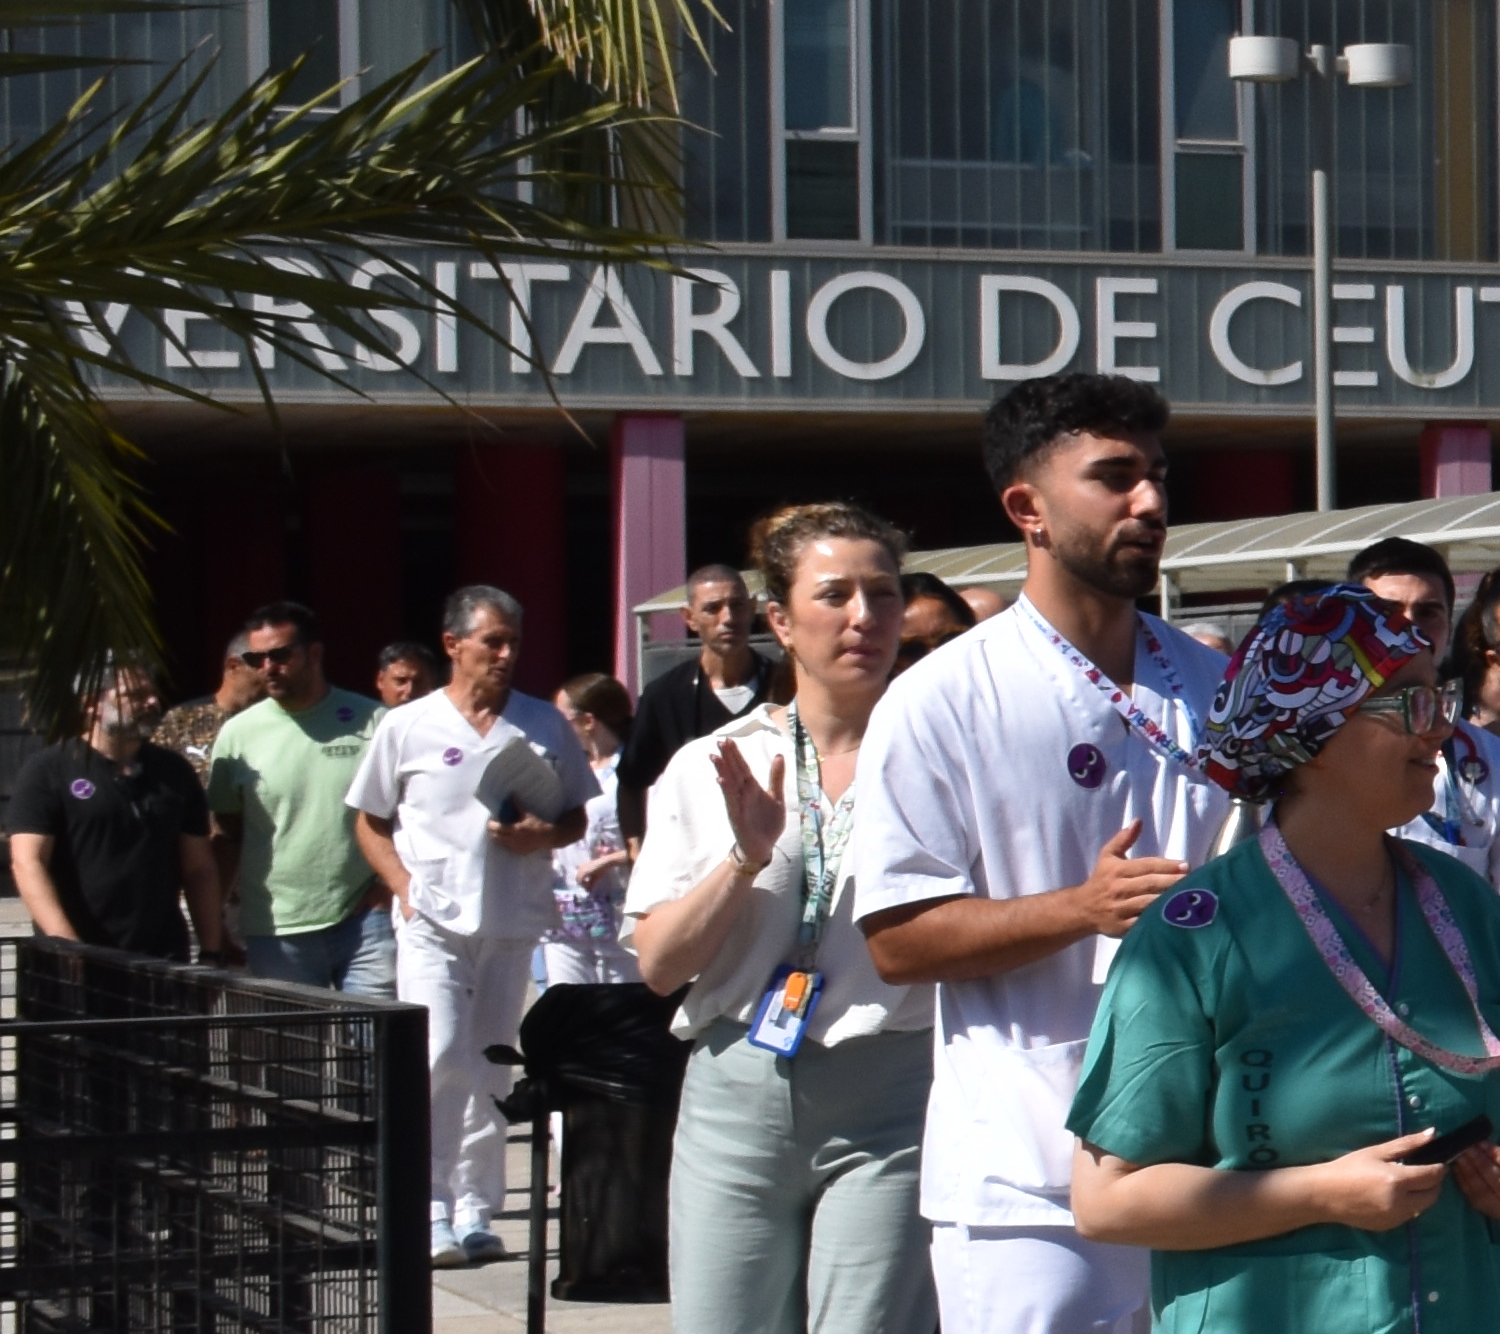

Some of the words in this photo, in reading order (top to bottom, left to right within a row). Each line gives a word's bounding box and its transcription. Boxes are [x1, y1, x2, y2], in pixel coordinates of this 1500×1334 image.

[58, 252, 926, 383] VERSITARIO
[980, 275, 1161, 383] DE
[1239, 1048, 1279, 1165] QUIRÓ
